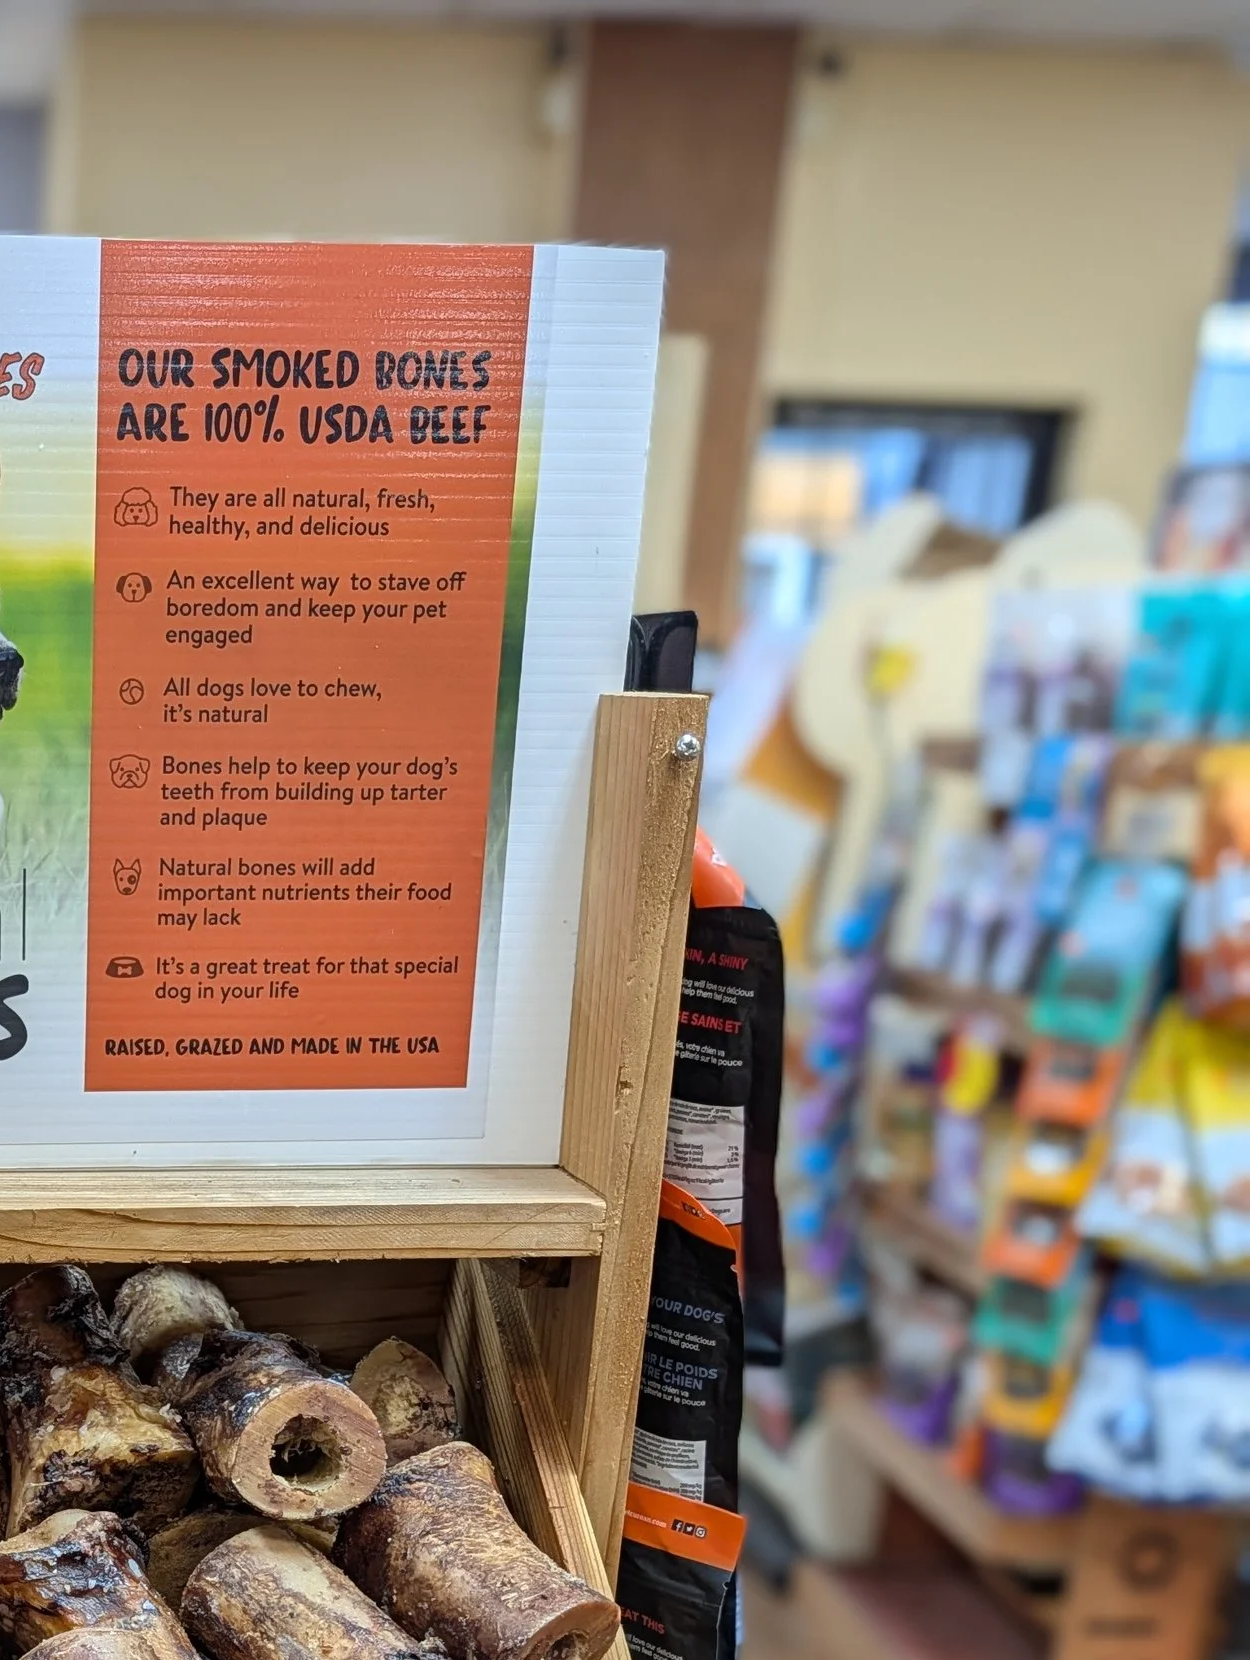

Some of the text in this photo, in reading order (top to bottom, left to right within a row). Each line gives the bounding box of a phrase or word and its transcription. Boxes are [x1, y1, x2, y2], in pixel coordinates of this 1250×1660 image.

[118, 348, 492, 392] OUR SMOKED BONES
[116, 394, 492, 445] ARE 100% USDA BEEF
[170, 486, 435, 513] They are all natural, fresh,
[169, 515, 389, 540] healthy, and delicious
[167, 570, 466, 597] An excellent way to stave off
[166, 598, 447, 625] boredom and keep your pet
[165, 625, 253, 648] engaged
[164, 678, 382, 702] All dogs love to chew,
[163, 704, 268, 724] it’s natural
[162, 756, 458, 781] Bones help to keep your dog’s
[161, 782, 447, 806] teeth from building up tarter
[160, 808, 268, 831] and plaque
[159, 858, 375, 877] Natural bones will add
[158, 883, 452, 906] important nutrients their food
[157, 908, 242, 931] may lack
[156, 956, 459, 981] It’s a great treat for that special
[719, 954, 748, 970] SHINY
[155, 982, 300, 1004] dog in your life
[691, 1013, 742, 1034] SAINS ET
[105, 1036, 440, 1058] RAISED, GRAZED AND MADE IN THE USA
[685, 1333, 716, 1346] delicious
[659, 1356, 674, 1370] LE
[675, 1362, 718, 1379] POIDS
[663, 1371, 703, 1390] CHIEN
[641, 1614, 665, 1634] THIS
